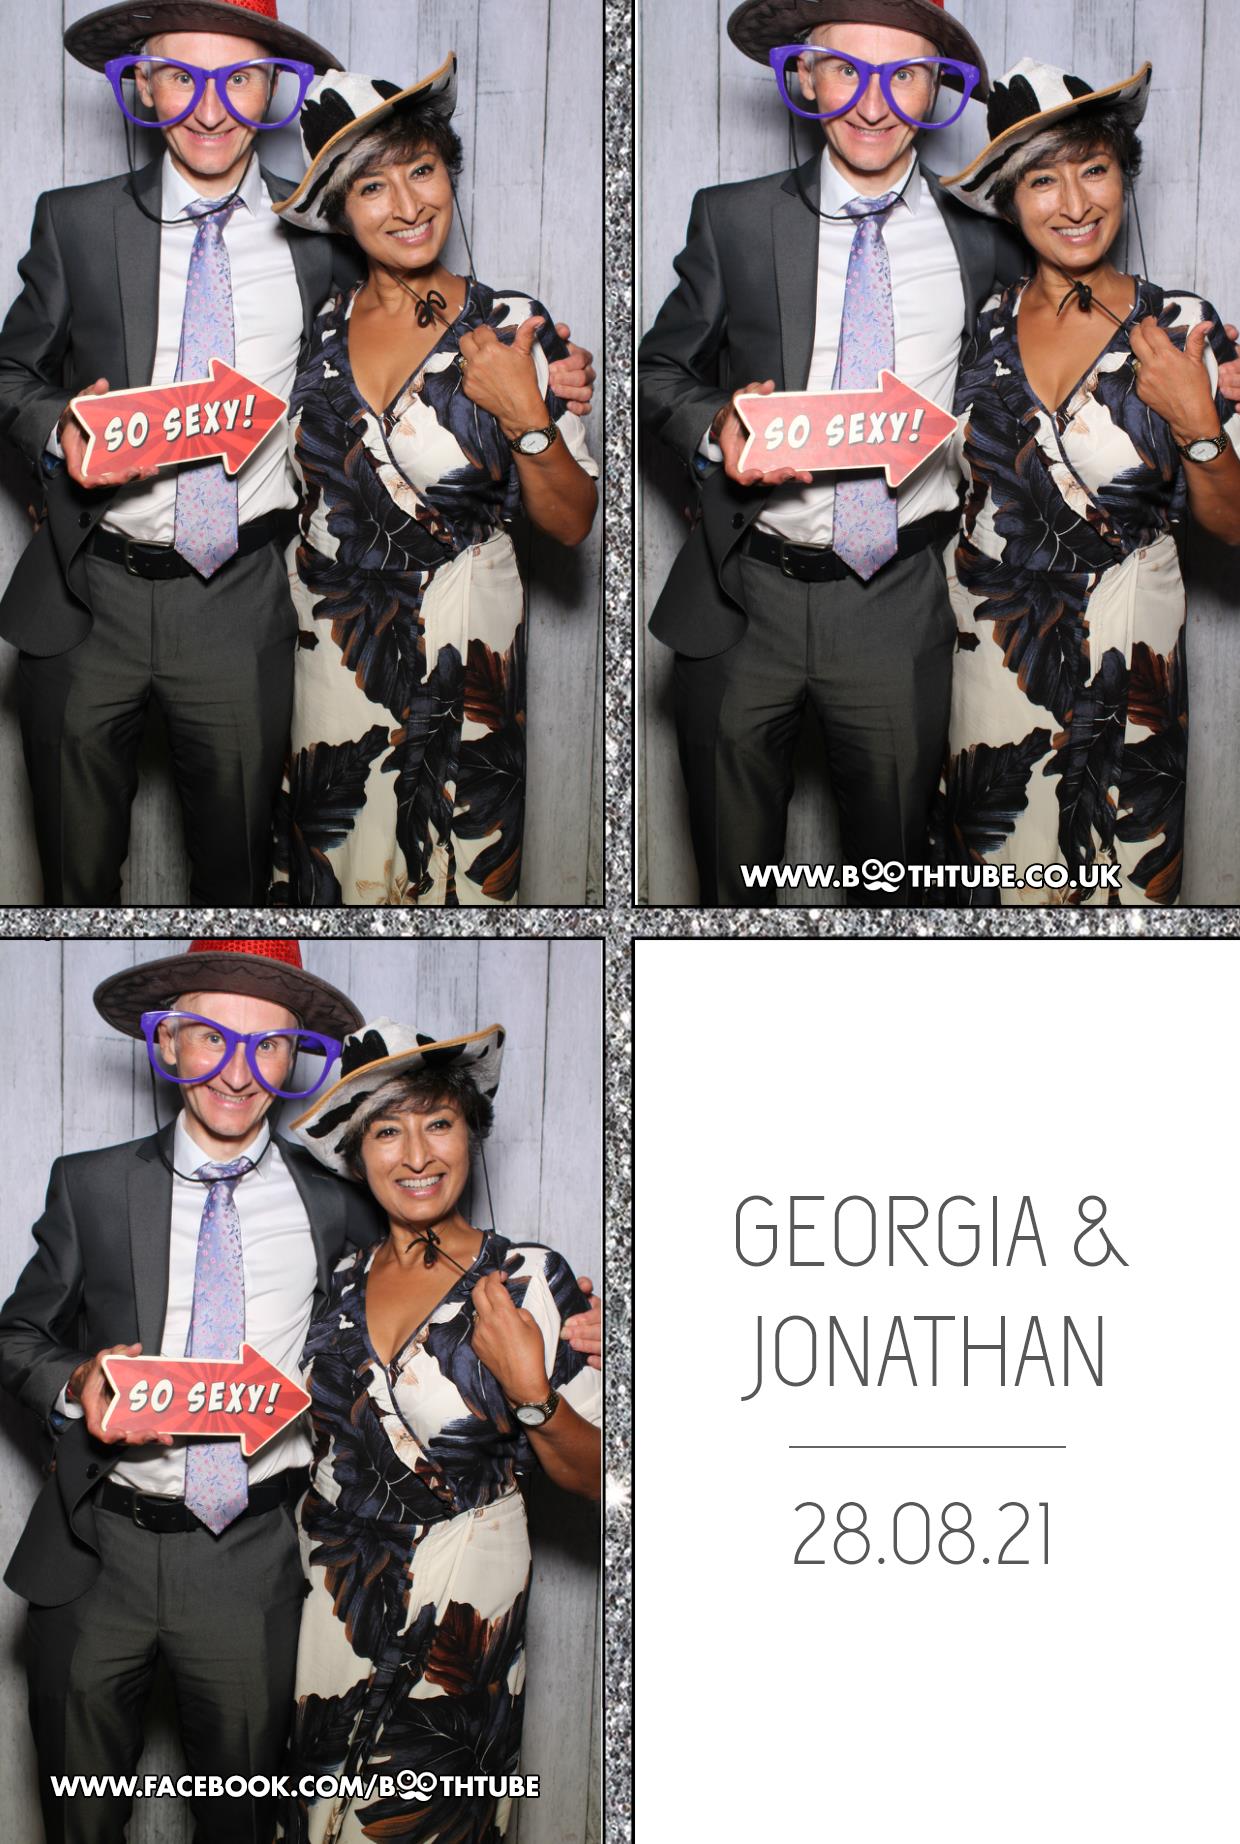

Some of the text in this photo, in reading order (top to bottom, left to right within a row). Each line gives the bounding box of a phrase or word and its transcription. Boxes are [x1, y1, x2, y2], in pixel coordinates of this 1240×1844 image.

[104, 395, 255, 451] SO SEXY!
[764, 408, 925, 450] SO SEXY!
[128, 1379, 281, 1415] SO SEXY!
